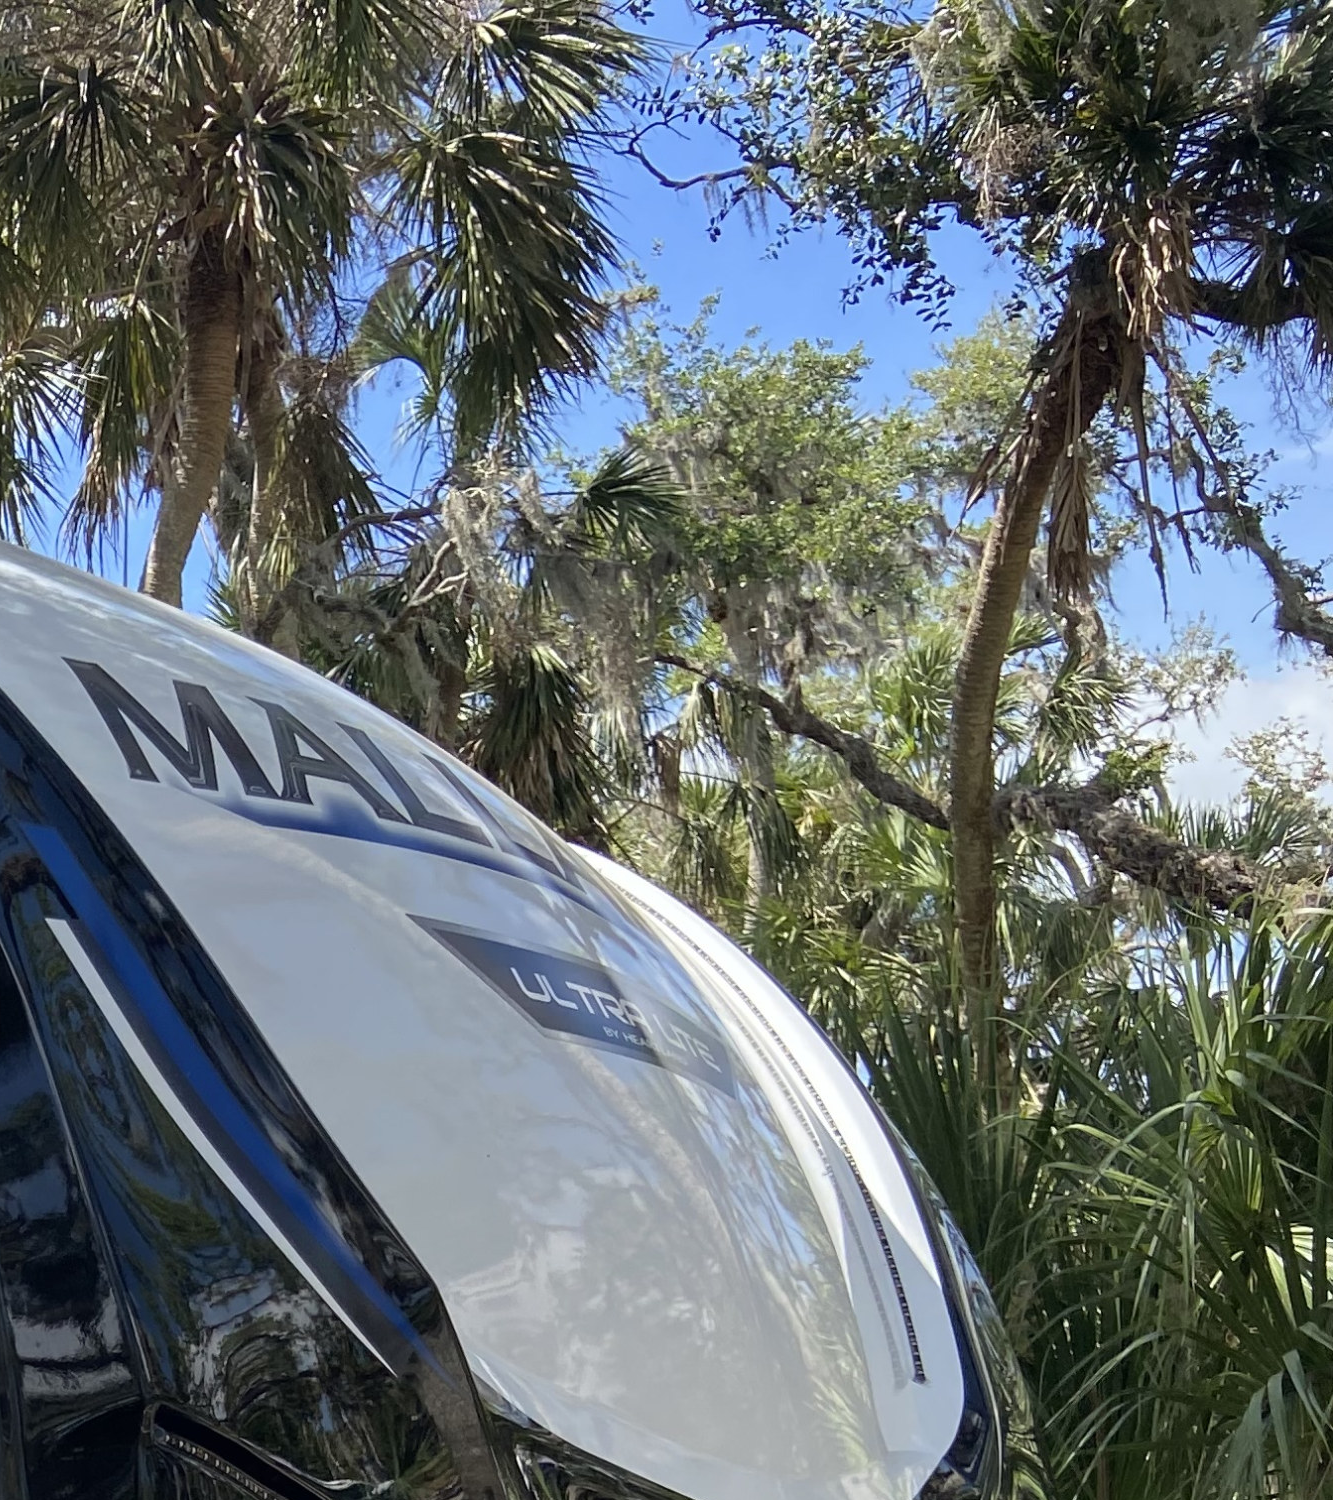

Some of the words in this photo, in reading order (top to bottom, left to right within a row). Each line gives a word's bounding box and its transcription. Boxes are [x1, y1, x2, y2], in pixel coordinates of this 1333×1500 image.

[62, 656, 587, 895] MALL
[510, 967, 653, 1034] ULTRA
[652, 1013, 722, 1073] LITE
